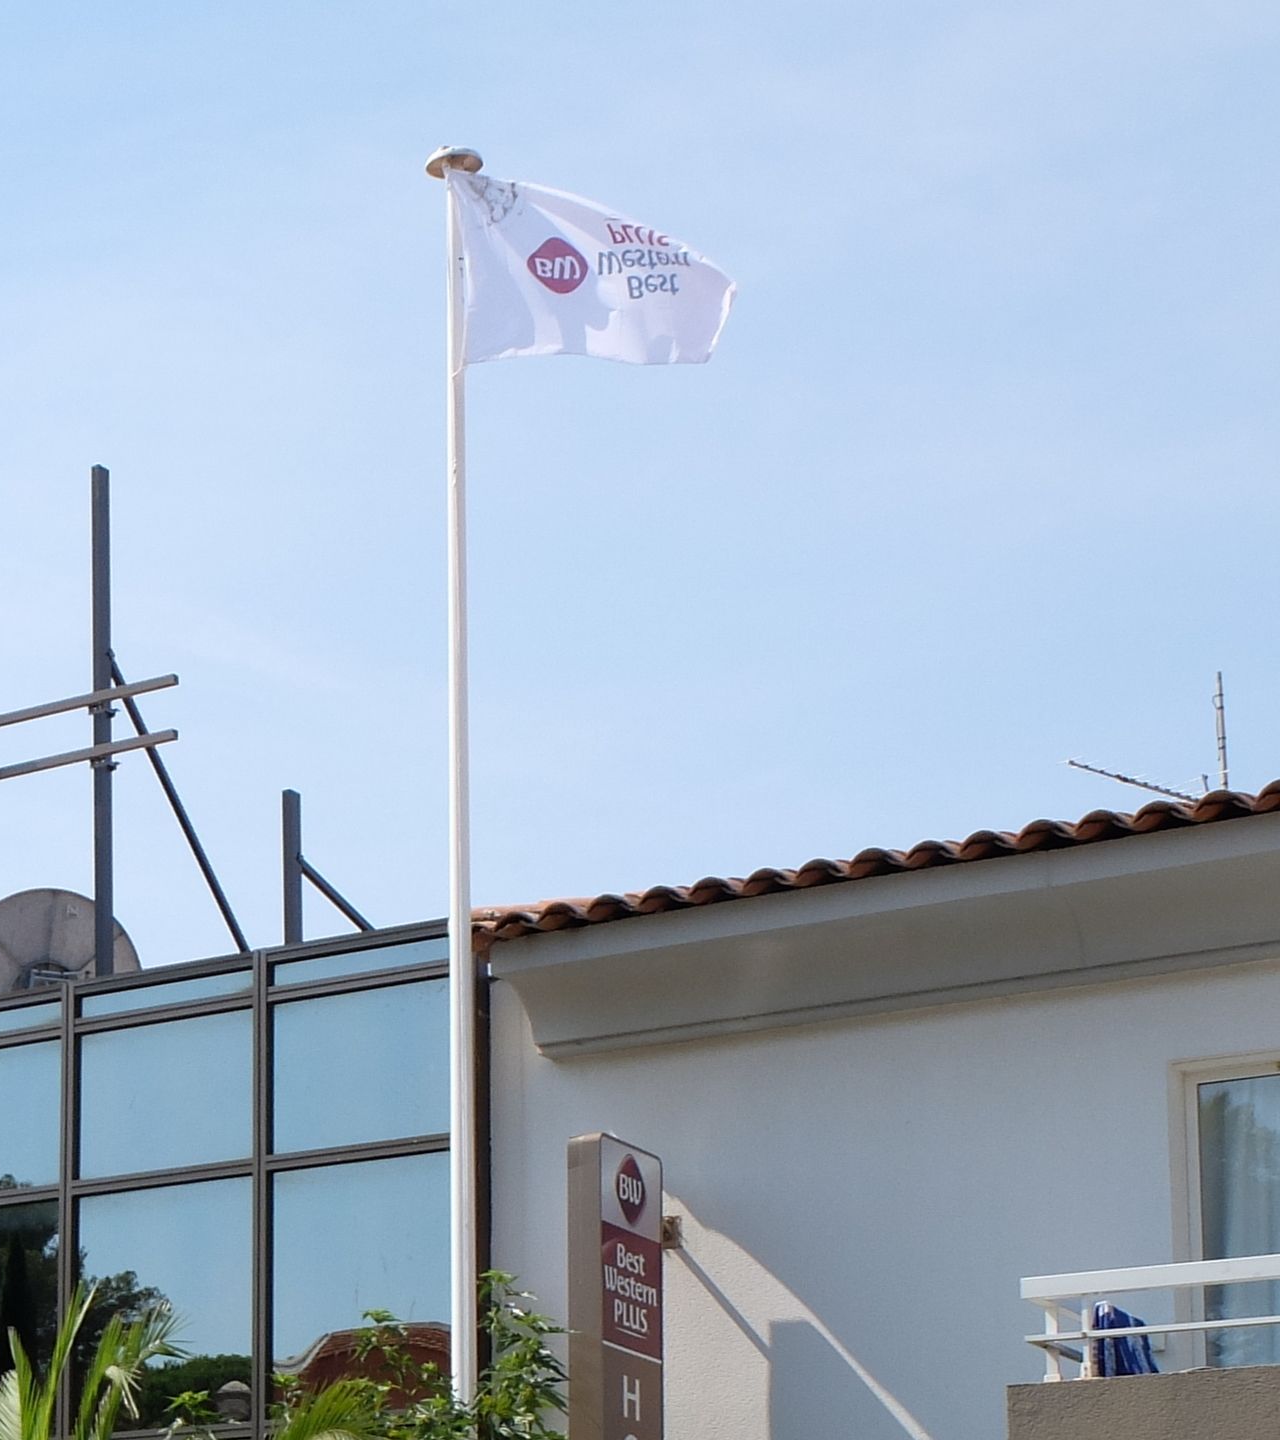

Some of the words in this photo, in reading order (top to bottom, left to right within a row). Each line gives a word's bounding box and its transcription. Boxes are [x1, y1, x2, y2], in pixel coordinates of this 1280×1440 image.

[618, 1172, 642, 1206] BW
[616, 1242, 646, 1277] Best
[603, 1264, 658, 1308] Western
[613, 1299, 648, 1333] PLUS
